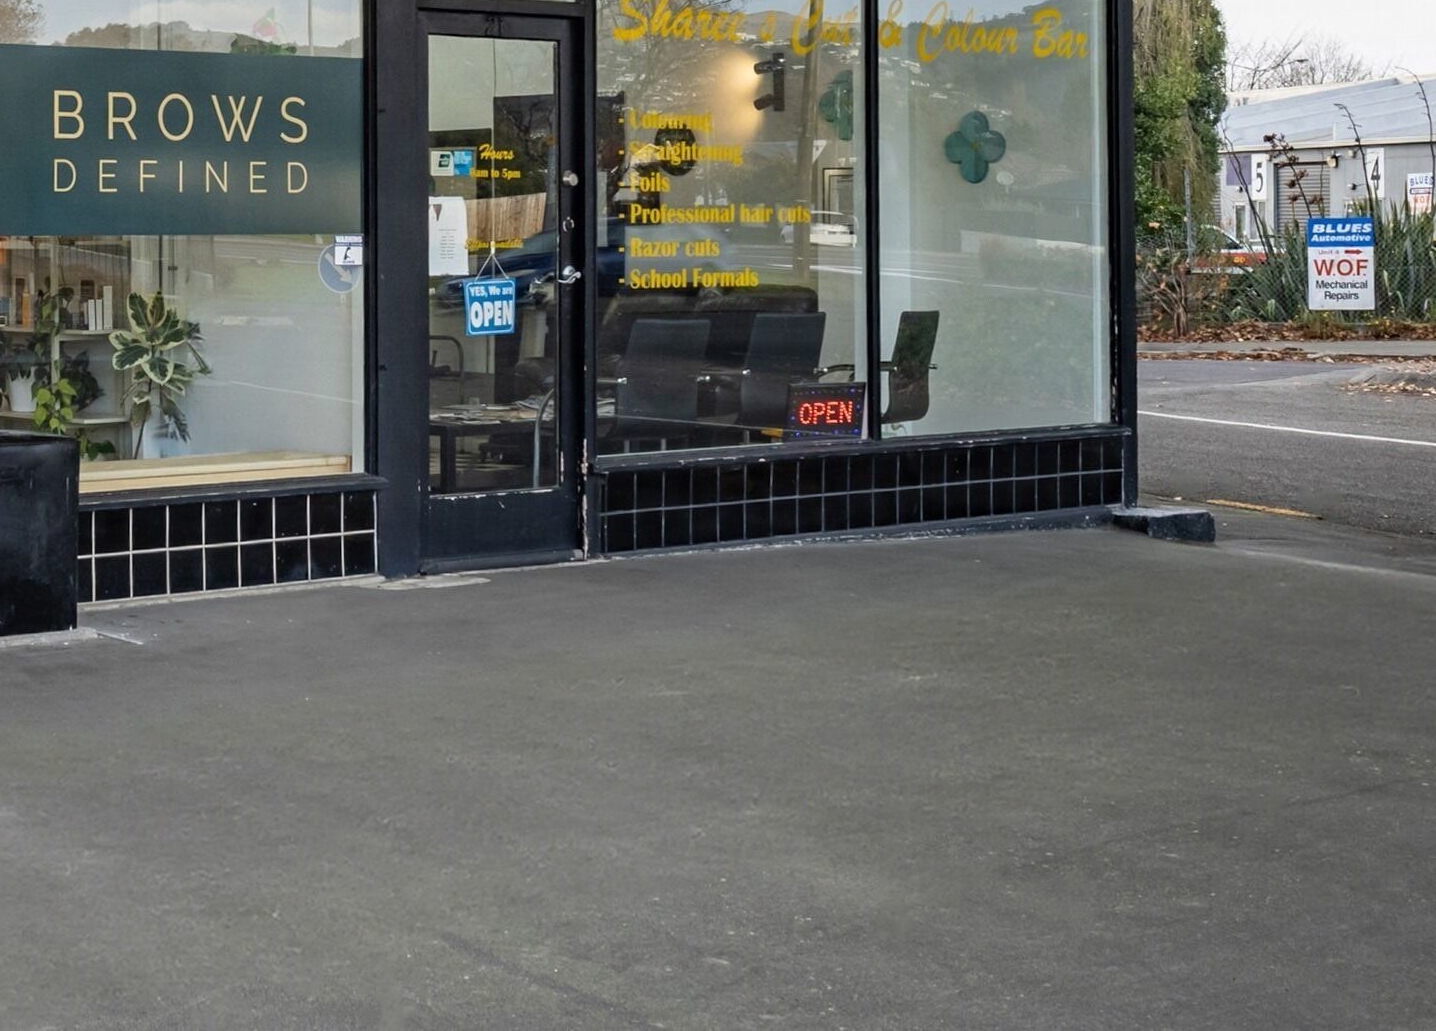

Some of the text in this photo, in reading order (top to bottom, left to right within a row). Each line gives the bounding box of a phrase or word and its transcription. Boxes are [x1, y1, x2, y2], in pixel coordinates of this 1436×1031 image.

[917, 0, 1019, 63] Colour
[1032, 6, 1089, 59] Bar
[53, 90, 309, 144] BROWS
[479, 143, 515, 160] Hours
[53, 158, 309, 194] DEFINED
[502, 168, 521, 180] 5pm
[629, 174, 671, 193] Foils
[1255, 162, 1264, 193] 5
[1370, 156, 1380, 191] 4
[630, 202, 812, 224] Professional hair cuts
[1311, 234, 1372, 243] Automotive
[1312, 223, 1373, 234] BLUES
[630, 237, 720, 258] Razor cuts
[630, 267, 759, 289] School Formals
[1316, 280, 1369, 290] Mechanical
[468, 285, 488, 298] YES,
[488, 285, 501, 296] We
[1324, 291, 1360, 302] Repairs
[470, 300, 513, 328] OPEN
[799, 401, 854, 425] OPEN
